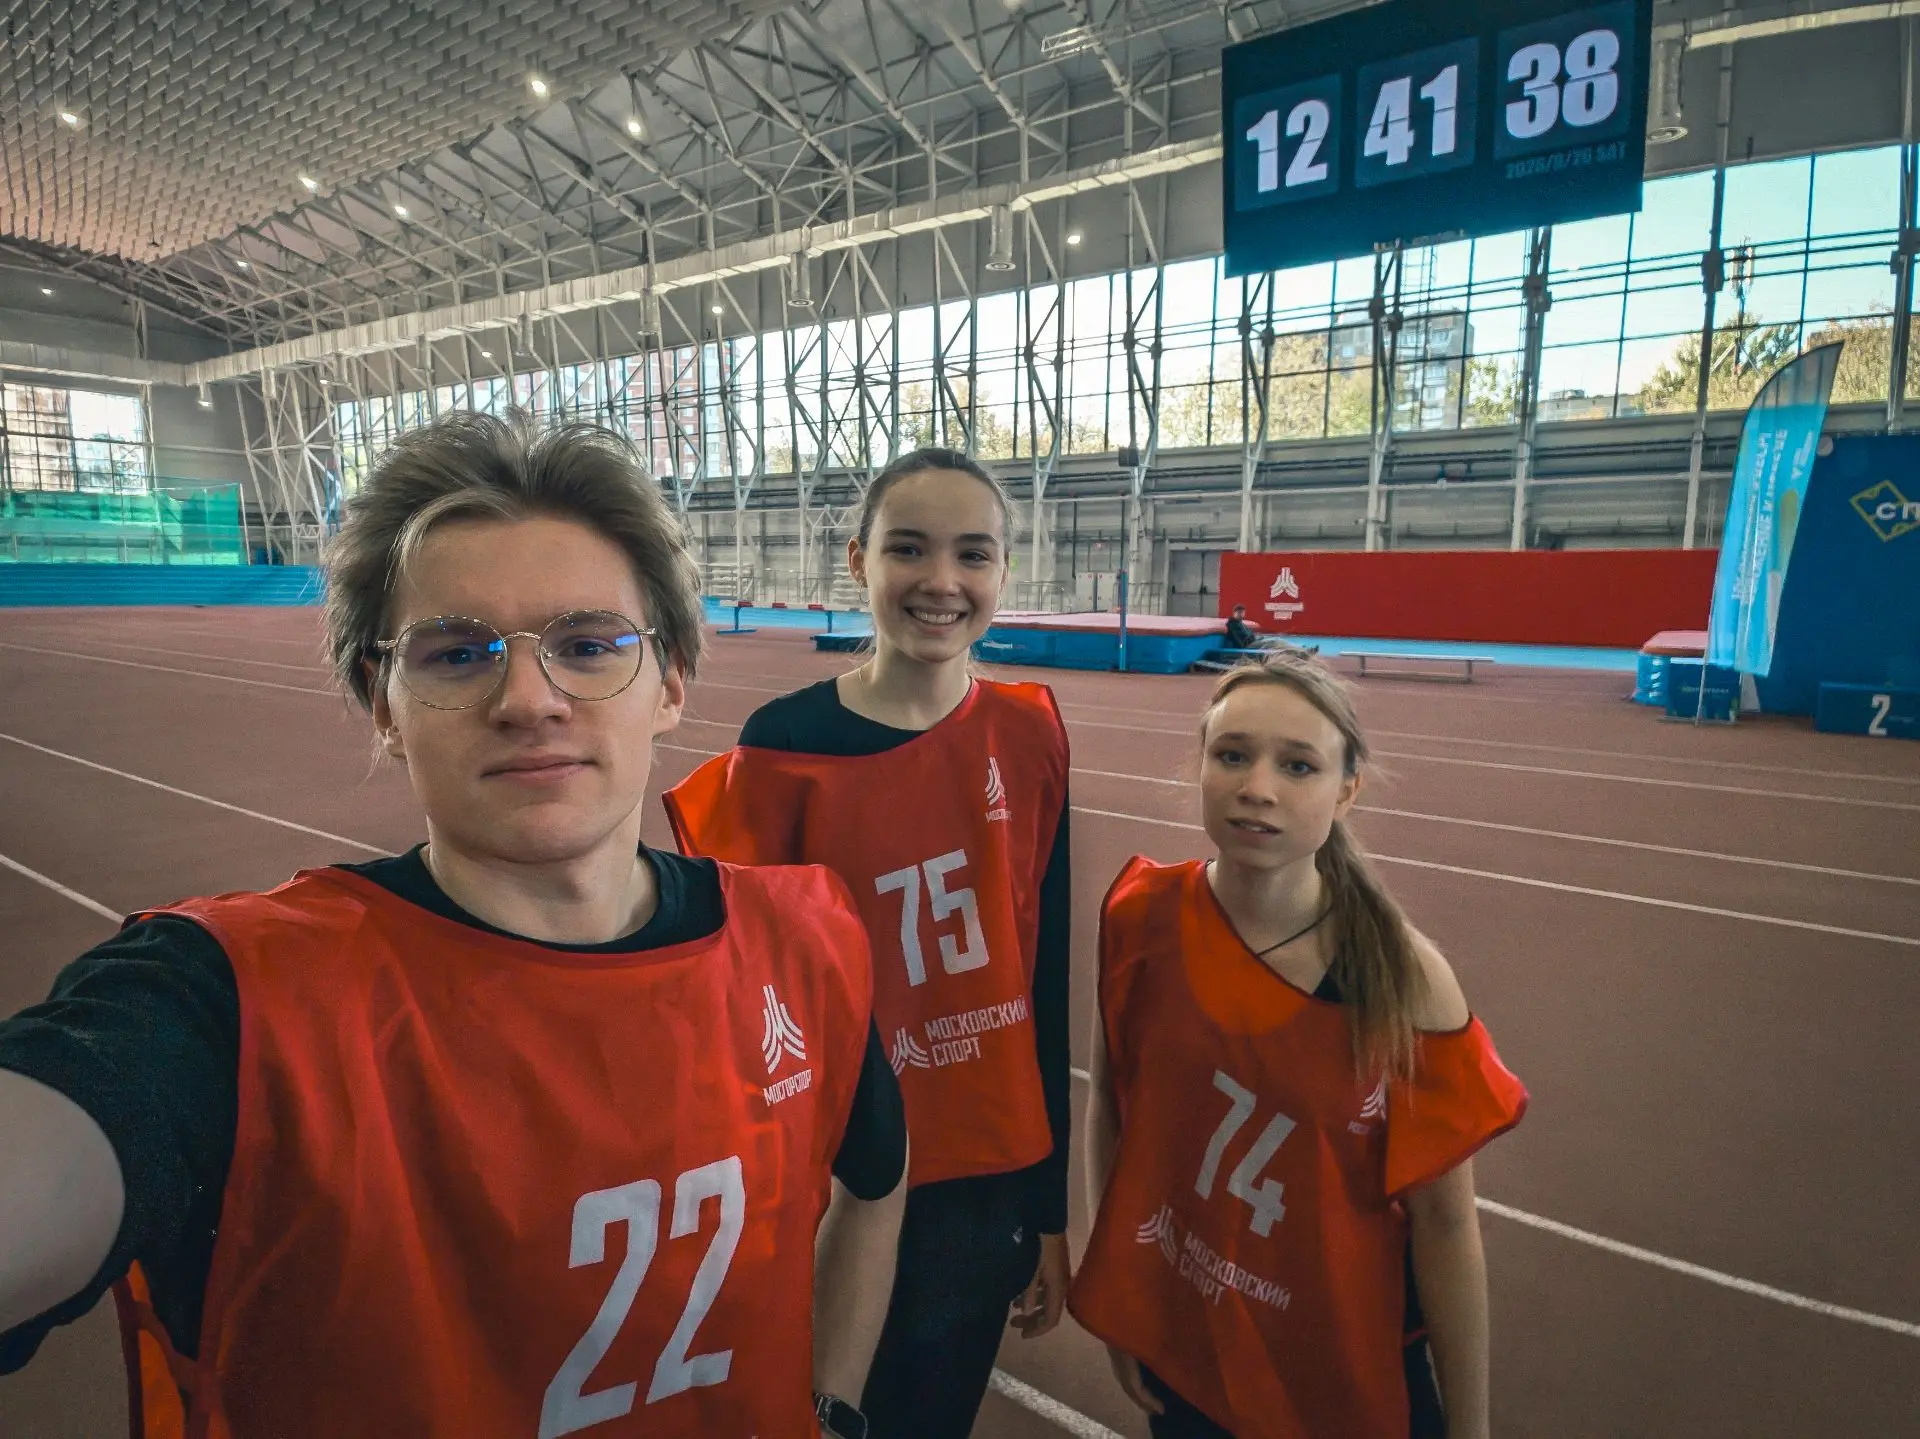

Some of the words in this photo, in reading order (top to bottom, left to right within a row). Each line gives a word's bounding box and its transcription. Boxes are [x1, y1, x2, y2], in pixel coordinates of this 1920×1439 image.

[1246, 99, 1330, 193] 12
[1364, 64, 1459, 166] 41
[1505, 29, 1620, 139] 38
[1868, 694, 1890, 736] 2
[875, 848, 989, 987] 75
[924, 995, 1028, 1042] МОСКОВСКИЙ
[931, 1036, 981, 1067] СПОРТ
[1194, 1069, 1297, 1238] 74
[538, 1155, 746, 1439] 22
[1184, 1231, 1292, 1312] МОСКОВСКИЙ
